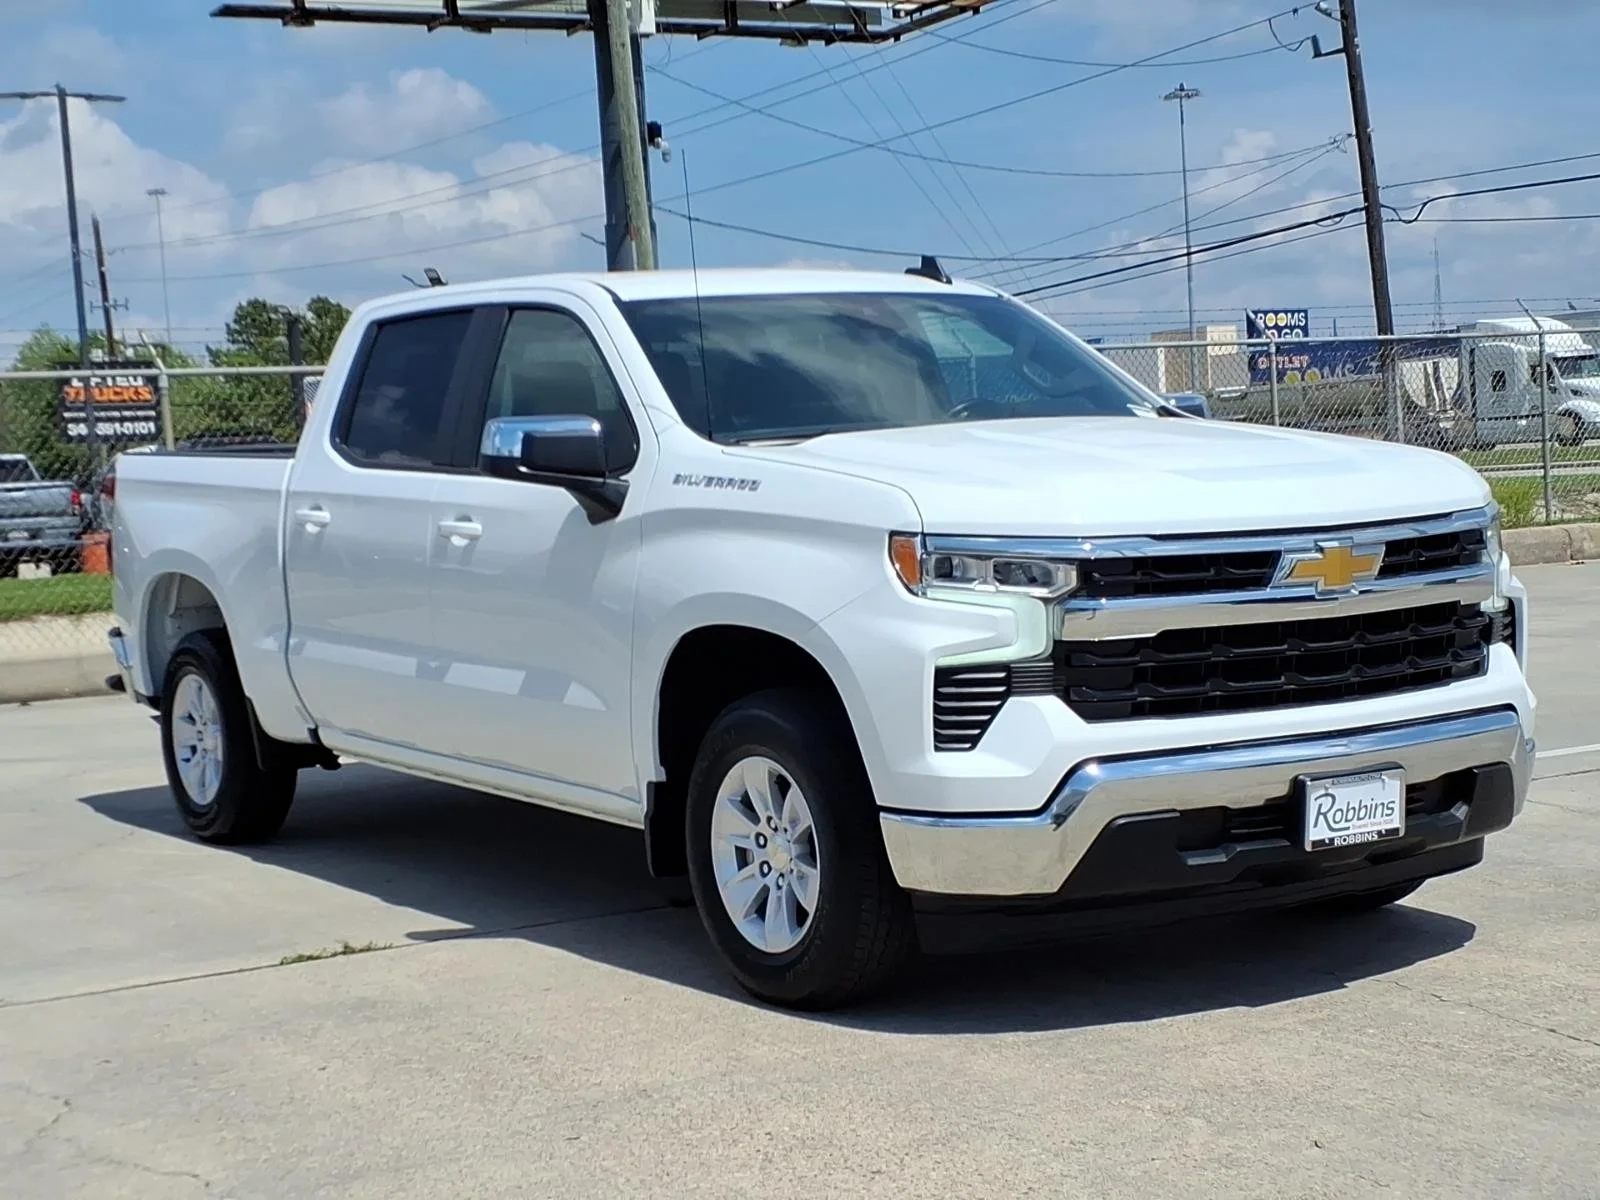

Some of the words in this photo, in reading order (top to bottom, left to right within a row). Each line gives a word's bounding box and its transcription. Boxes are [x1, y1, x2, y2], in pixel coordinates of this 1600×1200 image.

[1256, 312, 1306, 327] ROOMS
[1258, 355, 1309, 369] OTLET
[672, 473, 761, 491] SILVERADO
[1313, 792, 1396, 833] Robbins
[1334, 831, 1378, 847] ROBBINS
